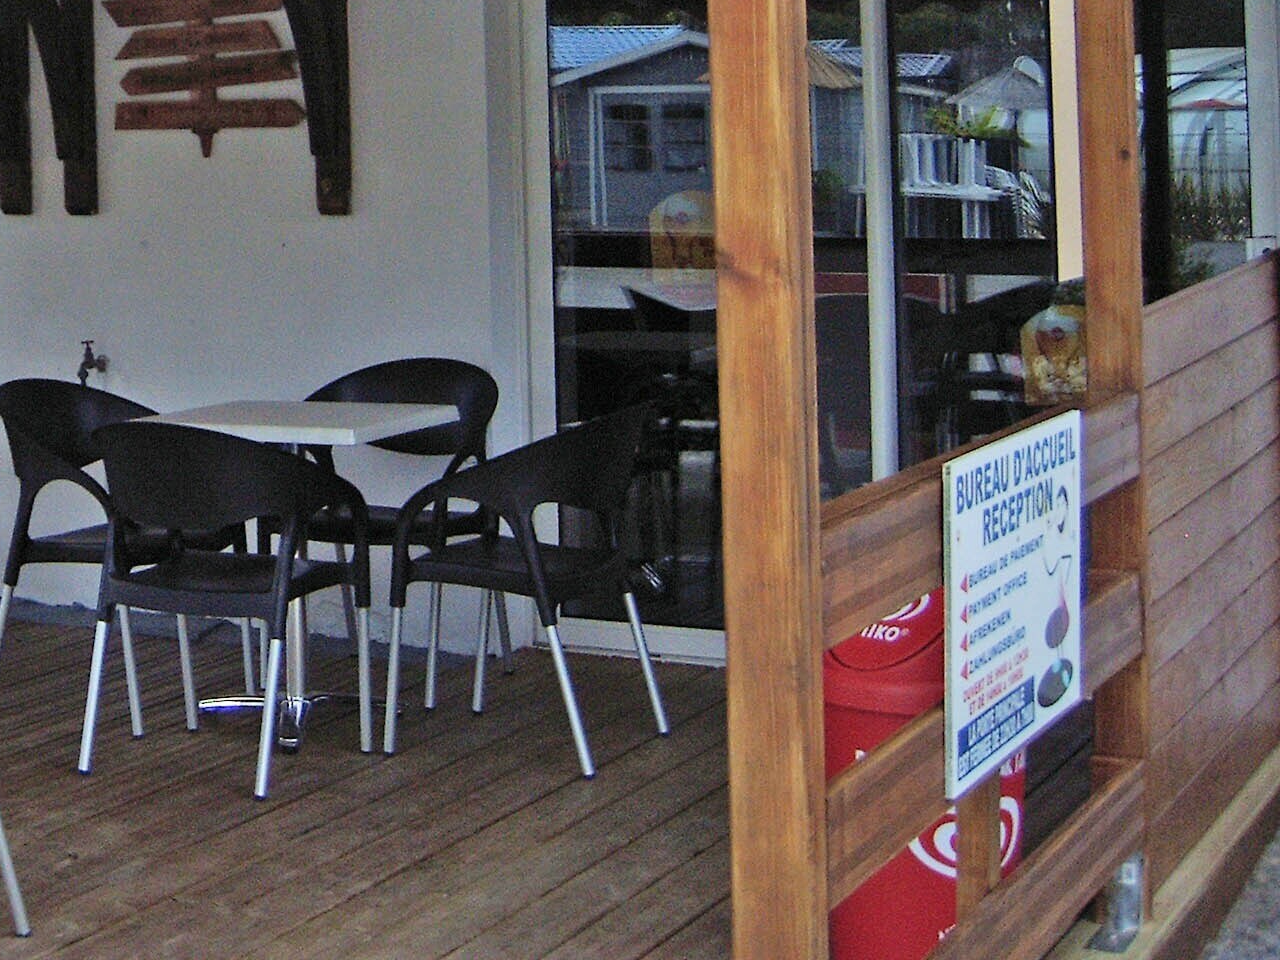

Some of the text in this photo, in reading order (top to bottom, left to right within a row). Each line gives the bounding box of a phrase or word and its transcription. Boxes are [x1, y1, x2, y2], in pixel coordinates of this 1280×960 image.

[956, 427, 1076, 515] BUREAU D'ACCUEIL
[983, 477, 1054, 547] RECEPTION
